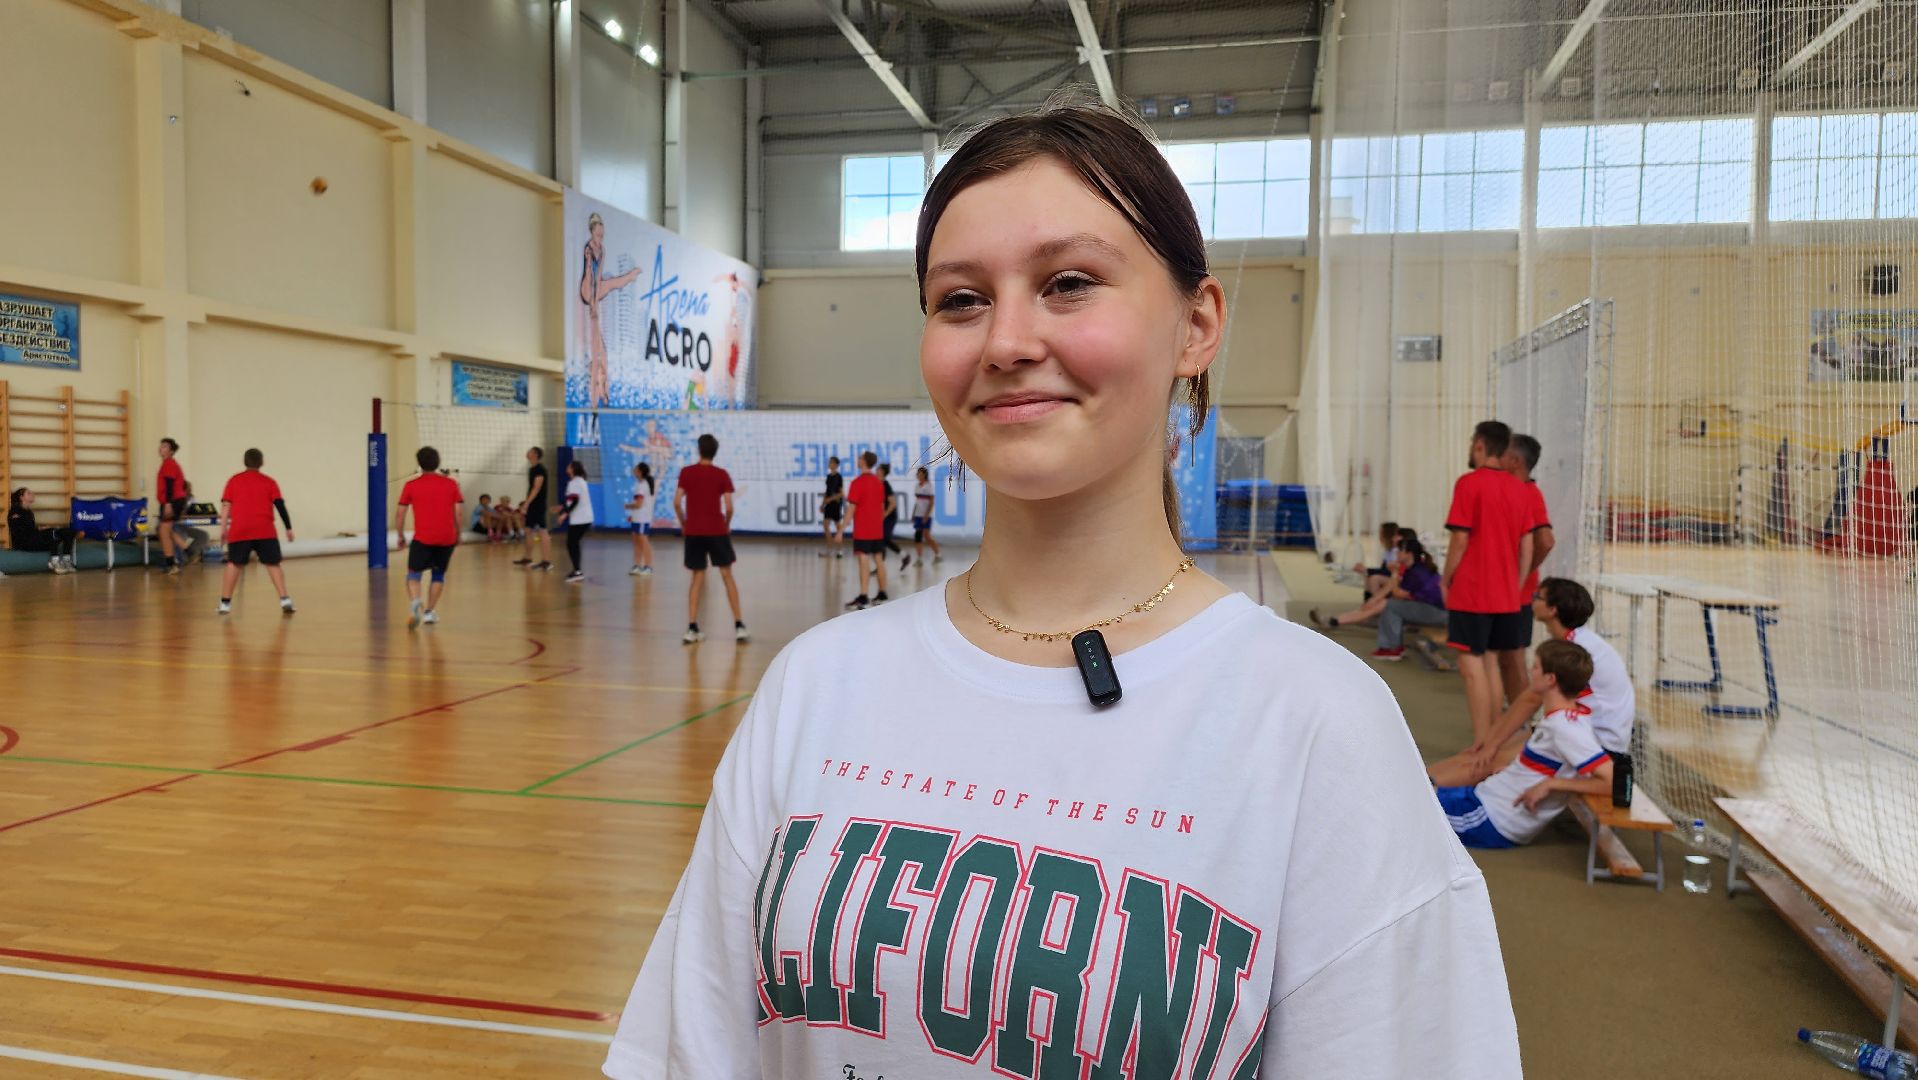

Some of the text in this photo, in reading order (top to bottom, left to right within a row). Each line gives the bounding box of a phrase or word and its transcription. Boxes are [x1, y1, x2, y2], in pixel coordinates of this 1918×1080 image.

[0, 333, 68, 350] ЕЗДЕЙСТВИЕ
[644, 318, 711, 372] ACRO
[822, 760, 1194, 833] THE STATE OF THE SUN
[753, 814, 1268, 1080] LIFORNI
